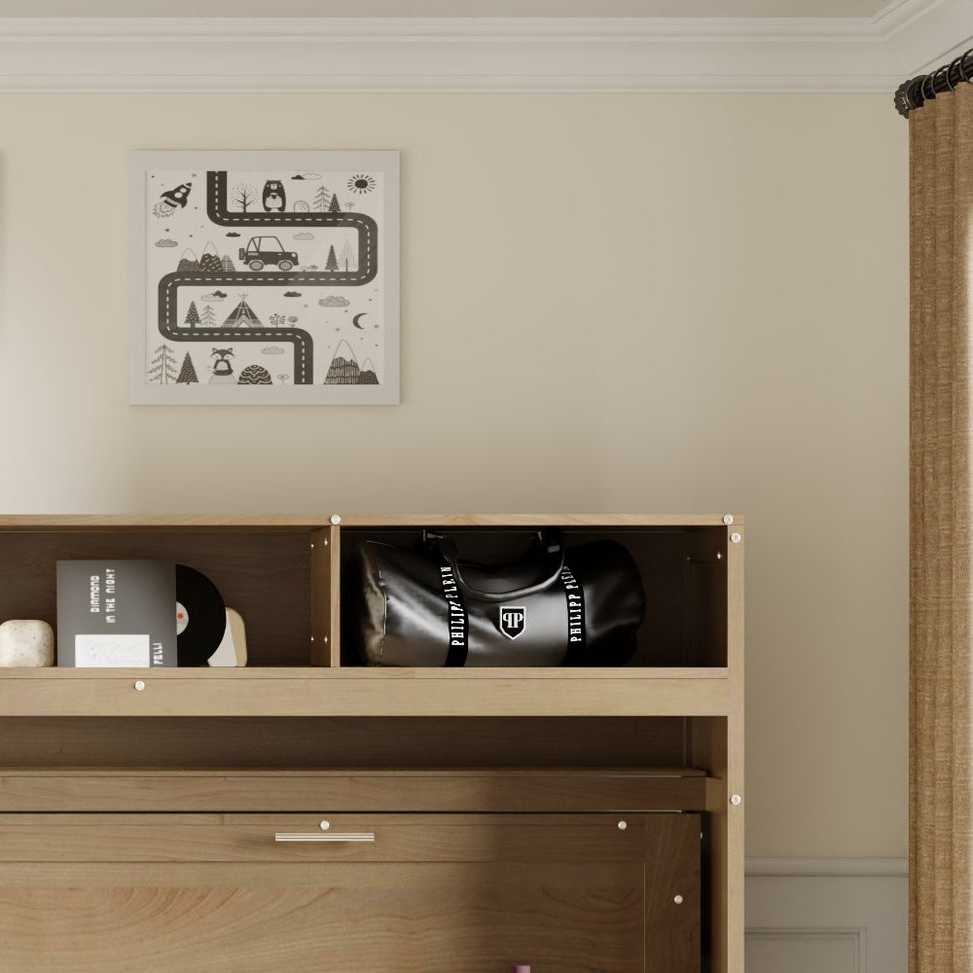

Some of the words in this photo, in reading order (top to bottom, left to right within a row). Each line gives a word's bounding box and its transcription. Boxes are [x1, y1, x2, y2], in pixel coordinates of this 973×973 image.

[90, 575, 100, 613] DIAMOND
[106, 568, 115, 594] NIGHT
[440, 566, 458, 599] PLEIN
[106, 597, 115, 613] THE
[568, 594, 582, 642] PHILIPP
